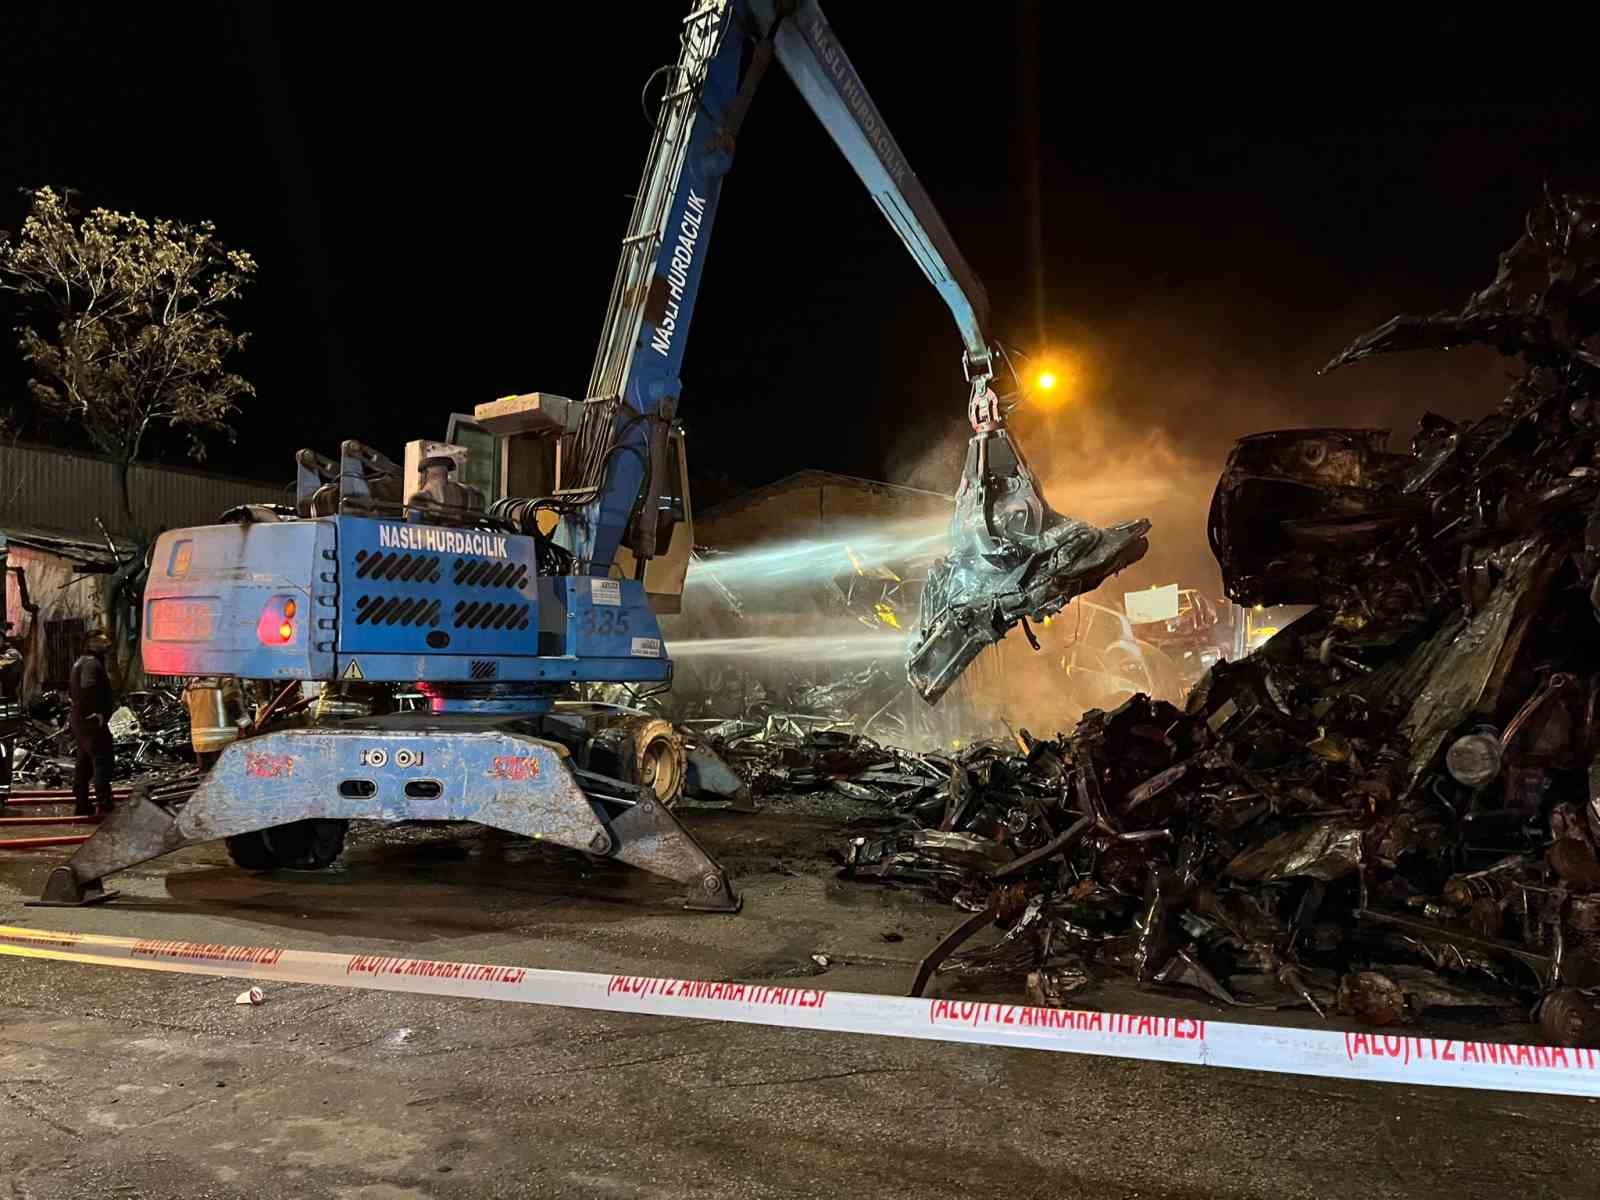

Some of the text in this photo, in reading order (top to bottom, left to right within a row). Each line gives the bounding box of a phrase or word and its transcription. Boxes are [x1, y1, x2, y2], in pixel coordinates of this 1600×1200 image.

[651, 189, 706, 357] NASLI HURDACILIK
[379, 525, 508, 558] NASLI HURDACILIK
